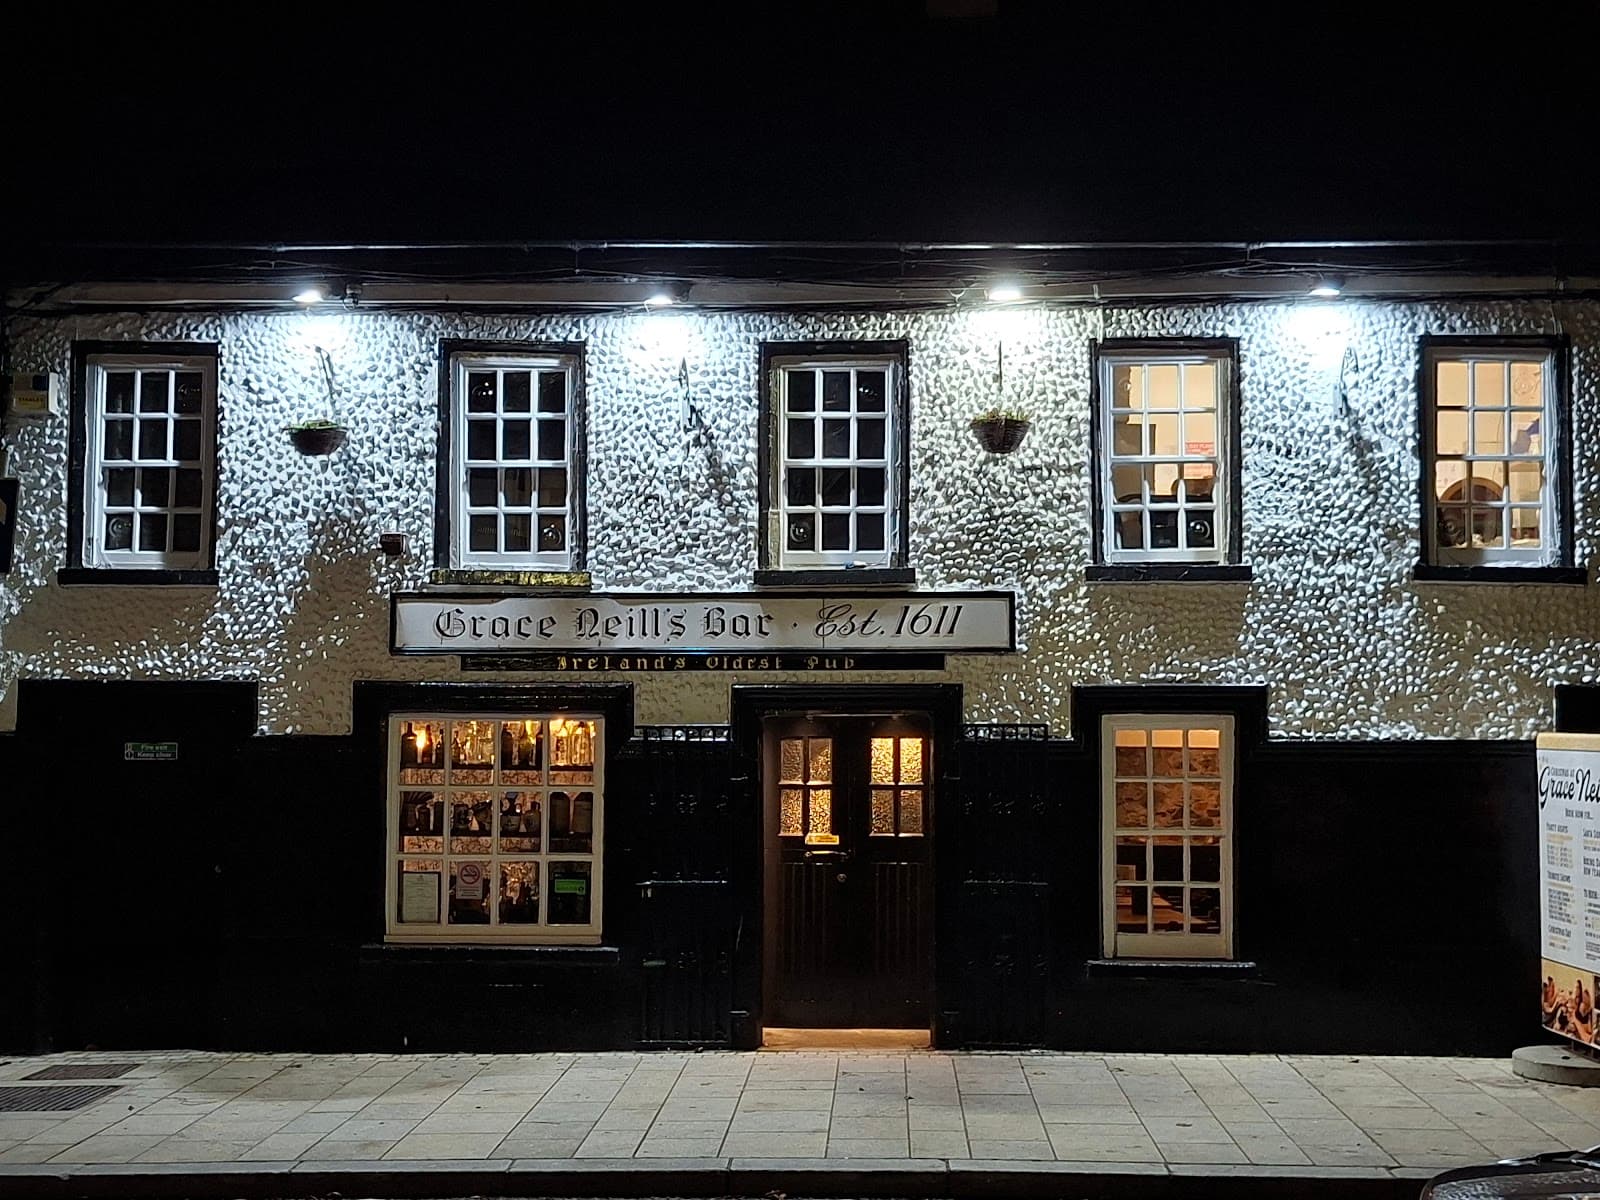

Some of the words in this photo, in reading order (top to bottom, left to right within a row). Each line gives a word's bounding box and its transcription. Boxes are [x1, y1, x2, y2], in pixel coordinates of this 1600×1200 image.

[434, 607, 557, 641] Grace
[575, 607, 688, 642] Neill's
[703, 606, 774, 639] Bar
[814, 603, 885, 638] Est.
[891, 603, 963, 638] 1611
[556, 655, 686, 670] Ireland's
[706, 656, 782, 669] Oldest
[804, 656, 855, 670] Pub
[1540, 766, 1575, 810] Grace
